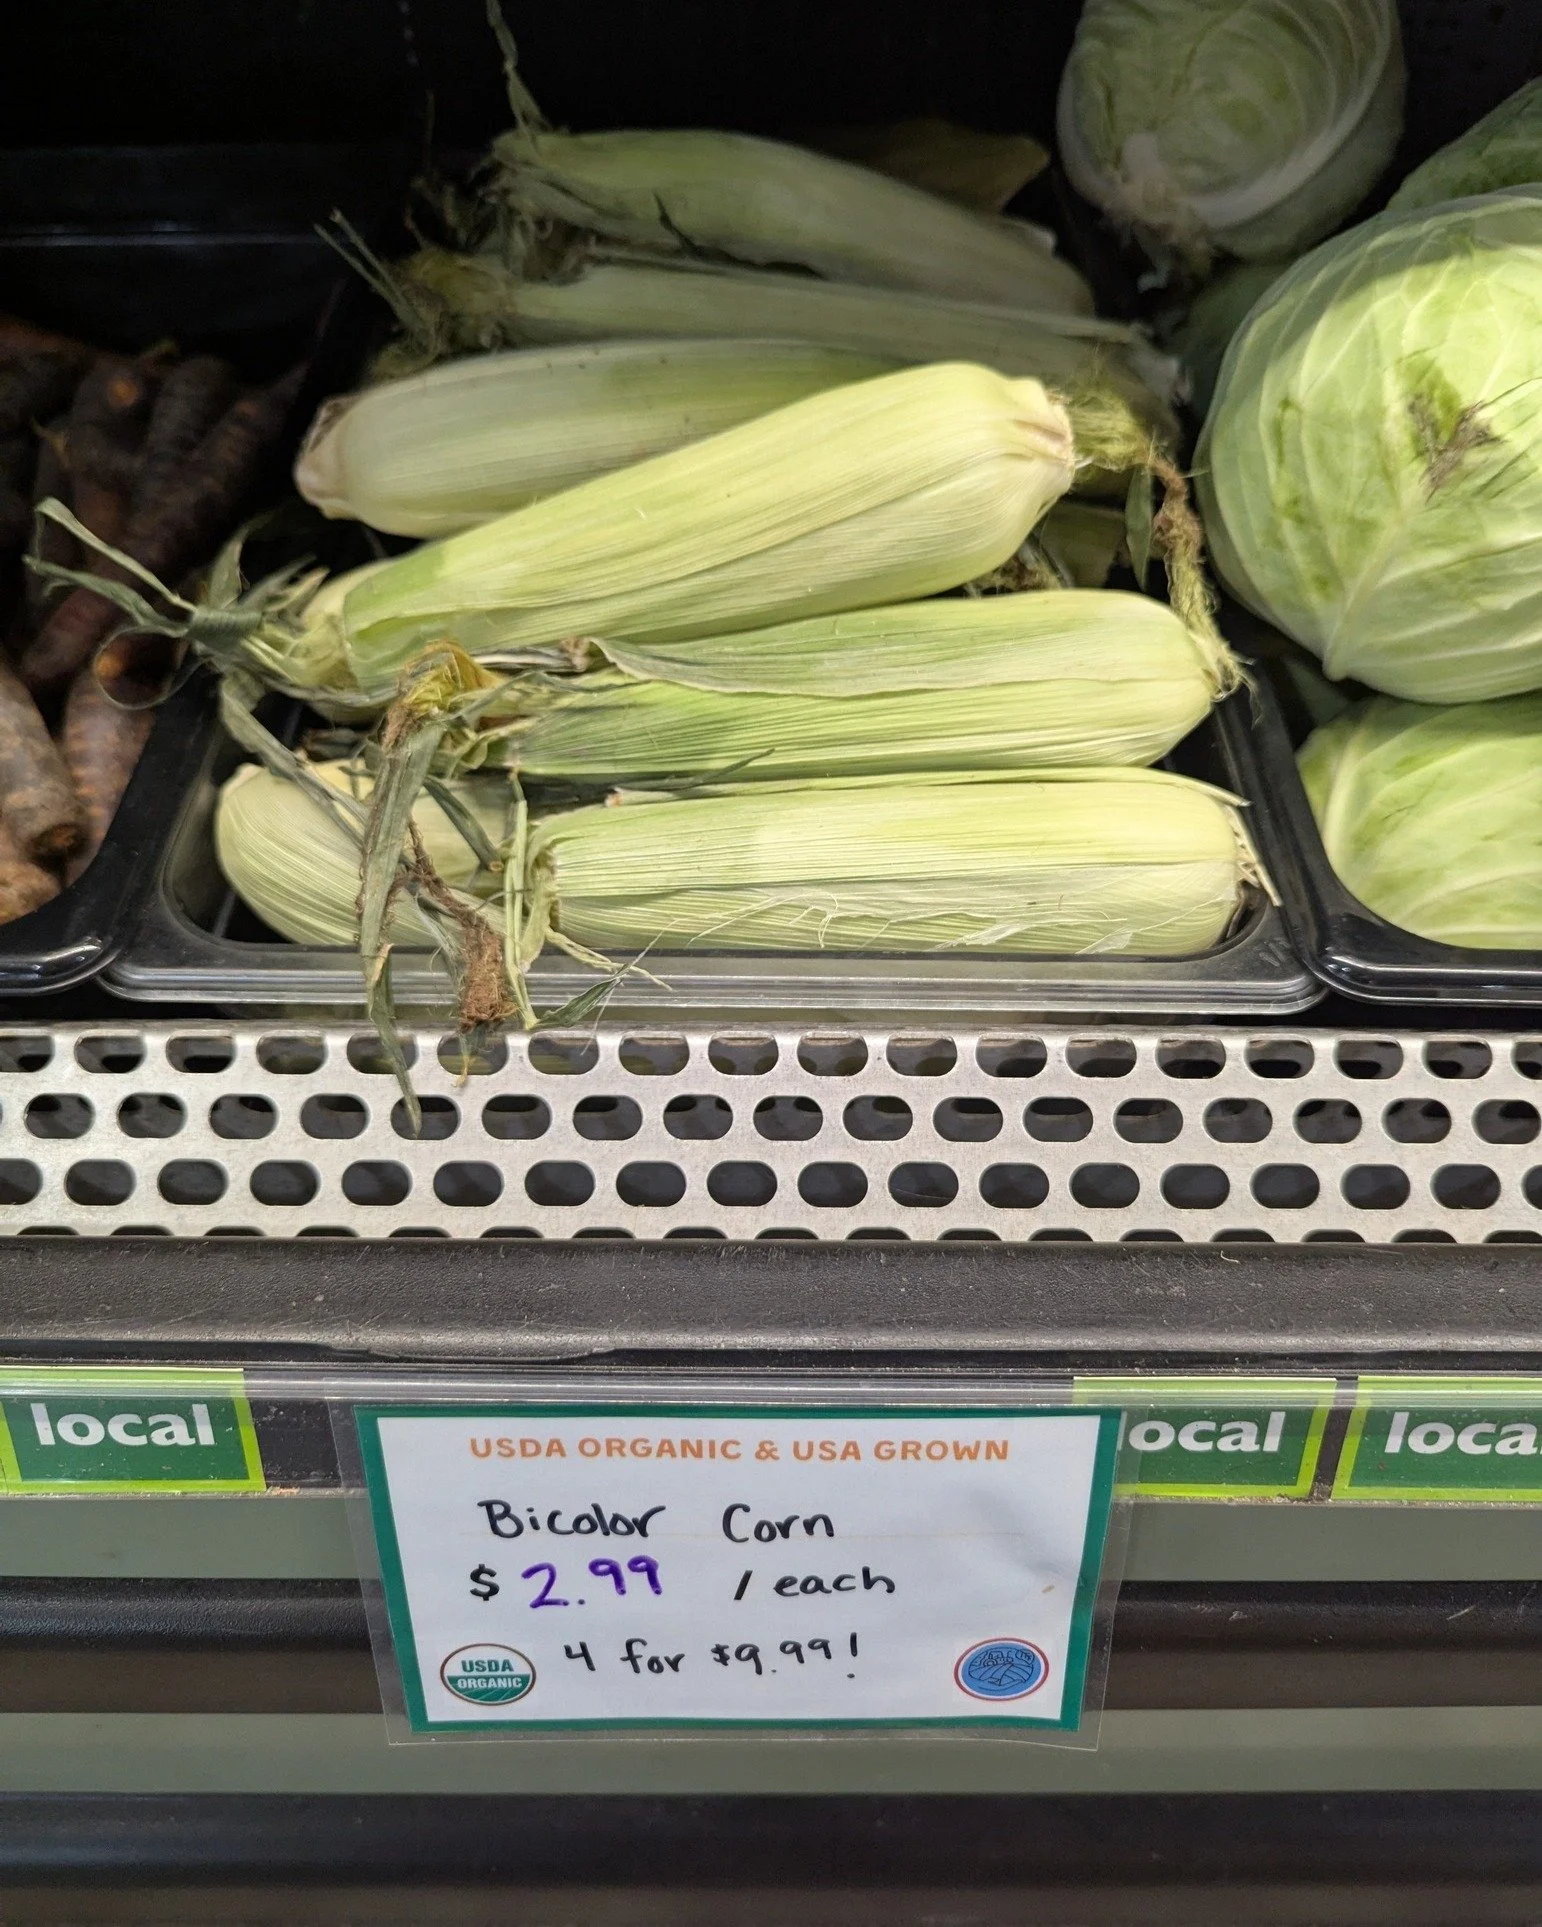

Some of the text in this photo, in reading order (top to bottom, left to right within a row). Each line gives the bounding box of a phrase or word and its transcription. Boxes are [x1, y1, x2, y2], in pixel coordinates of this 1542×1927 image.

[31, 1402, 216, 1447] local
[1384, 1411, 1542, 1456] loca
[470, 1438, 1010, 1462] USDA ORGANIC & USA GROWN
[477, 1499, 835, 1544] Bicolor Corn
[772, 1565, 897, 1598] each
[461, 1659, 514, 1673] USDA
[563, 1631, 858, 1680] 4 for $9.99!
[457, 1677, 522, 1689] ORGANIC
